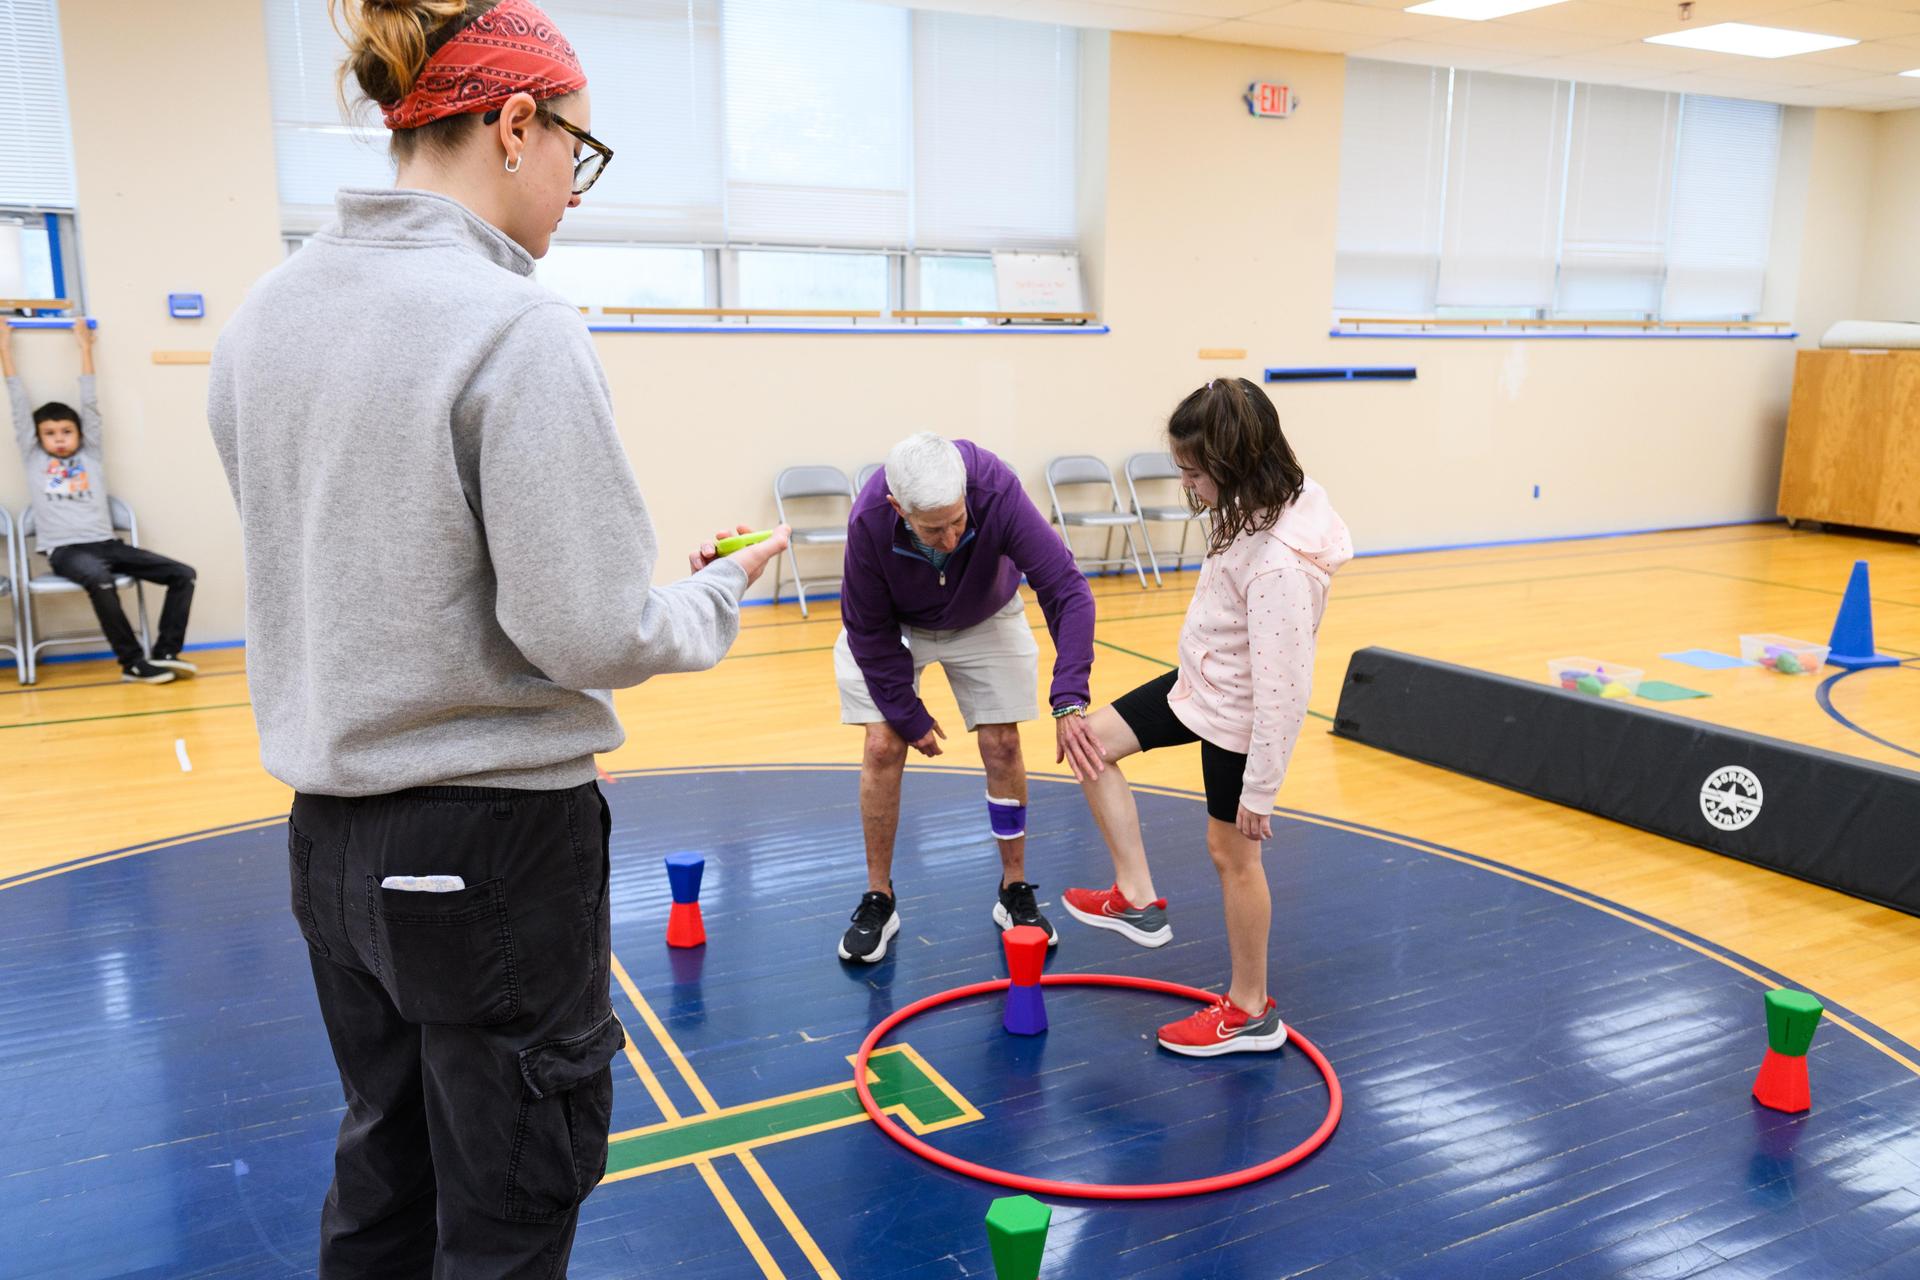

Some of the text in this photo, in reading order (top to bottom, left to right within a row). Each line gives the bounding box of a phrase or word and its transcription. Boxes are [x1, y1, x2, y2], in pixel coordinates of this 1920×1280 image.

[1261, 83, 1289, 113] EXIT
[1710, 771, 1757, 797] BORDER
[1705, 801, 1751, 825] PATROL
